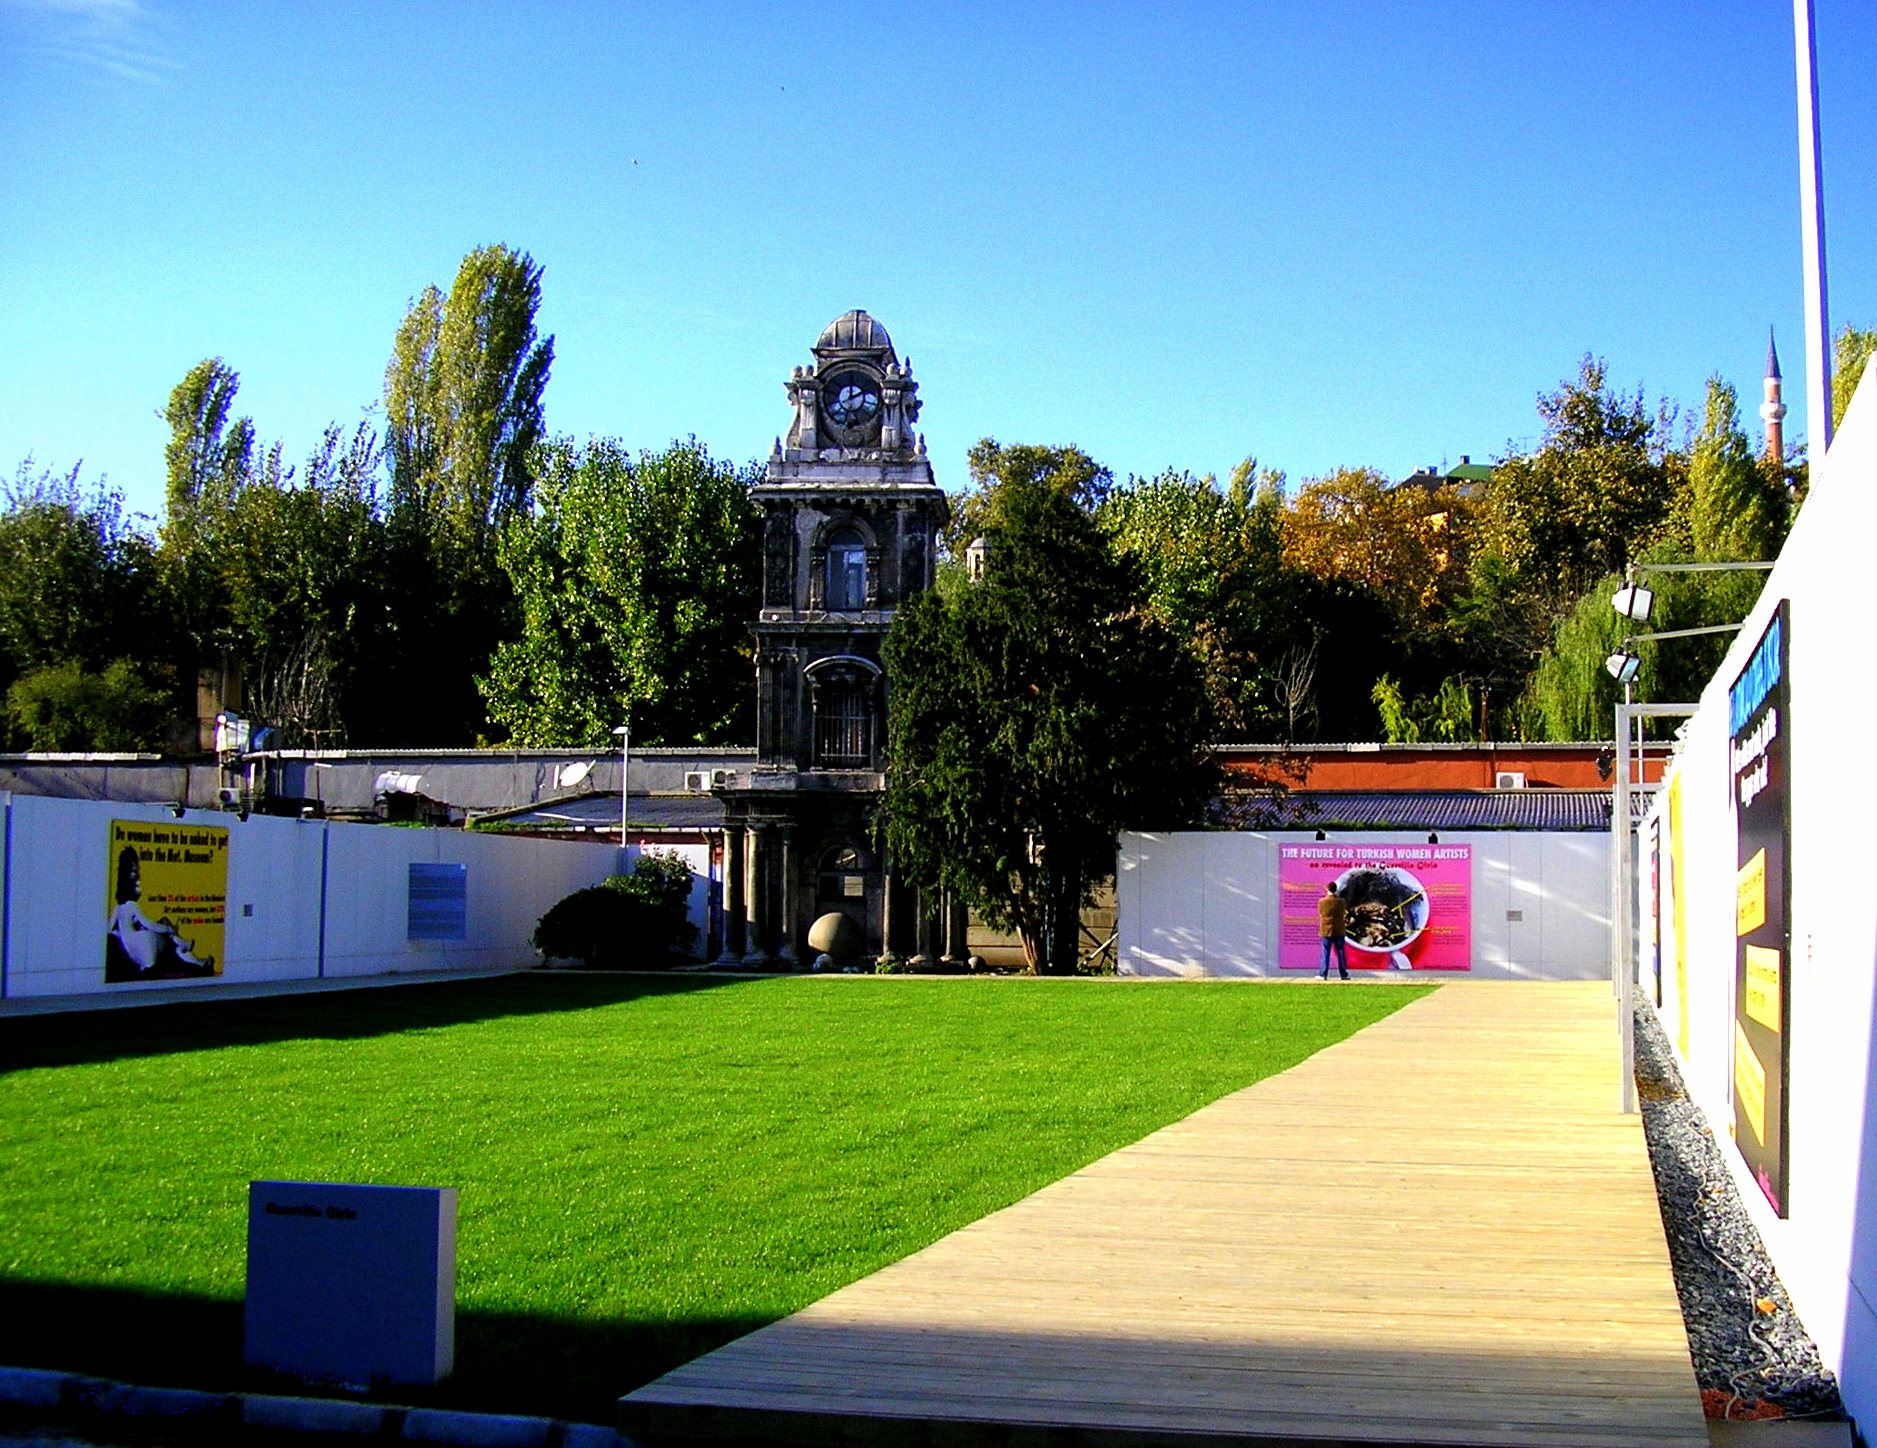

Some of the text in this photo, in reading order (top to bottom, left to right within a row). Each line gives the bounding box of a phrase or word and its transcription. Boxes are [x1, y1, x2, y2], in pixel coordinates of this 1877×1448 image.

[116, 826, 125, 840] Do
[127, 831, 152, 843] women
[154, 827, 170, 844] have
[172, 832, 179, 845] to
[180, 830, 188, 846] be
[190, 831, 209, 846] naked
[211, 833, 217, 846] to
[140, 846, 153, 862] into
[155, 848, 166, 862] the
[1282, 848, 1469, 859] THE FUTURE FOR TURKISH WOMEN ARTISTS
